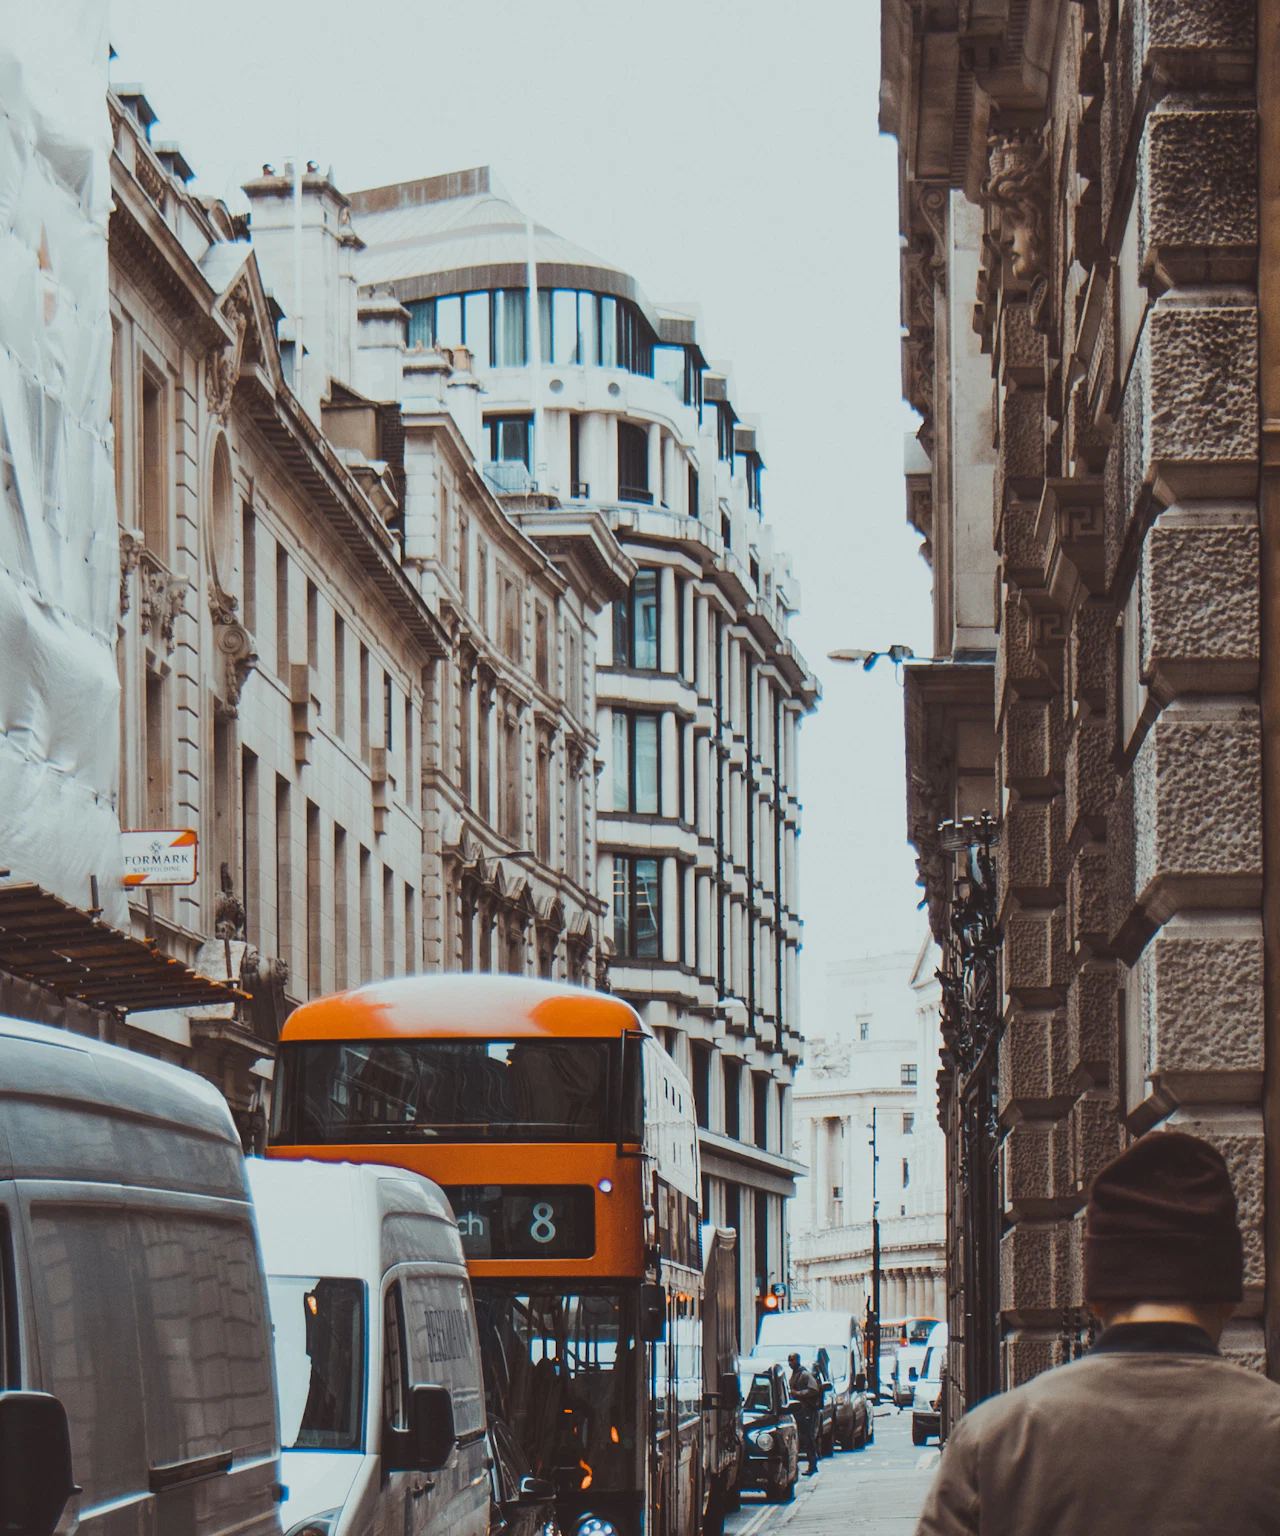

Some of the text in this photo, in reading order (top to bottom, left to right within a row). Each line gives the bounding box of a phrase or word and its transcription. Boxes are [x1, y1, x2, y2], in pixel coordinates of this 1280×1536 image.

[124, 854, 189, 866] FORMARK
[457, 1210, 483, 1236] ch
[531, 1202, 556, 1243] 8
